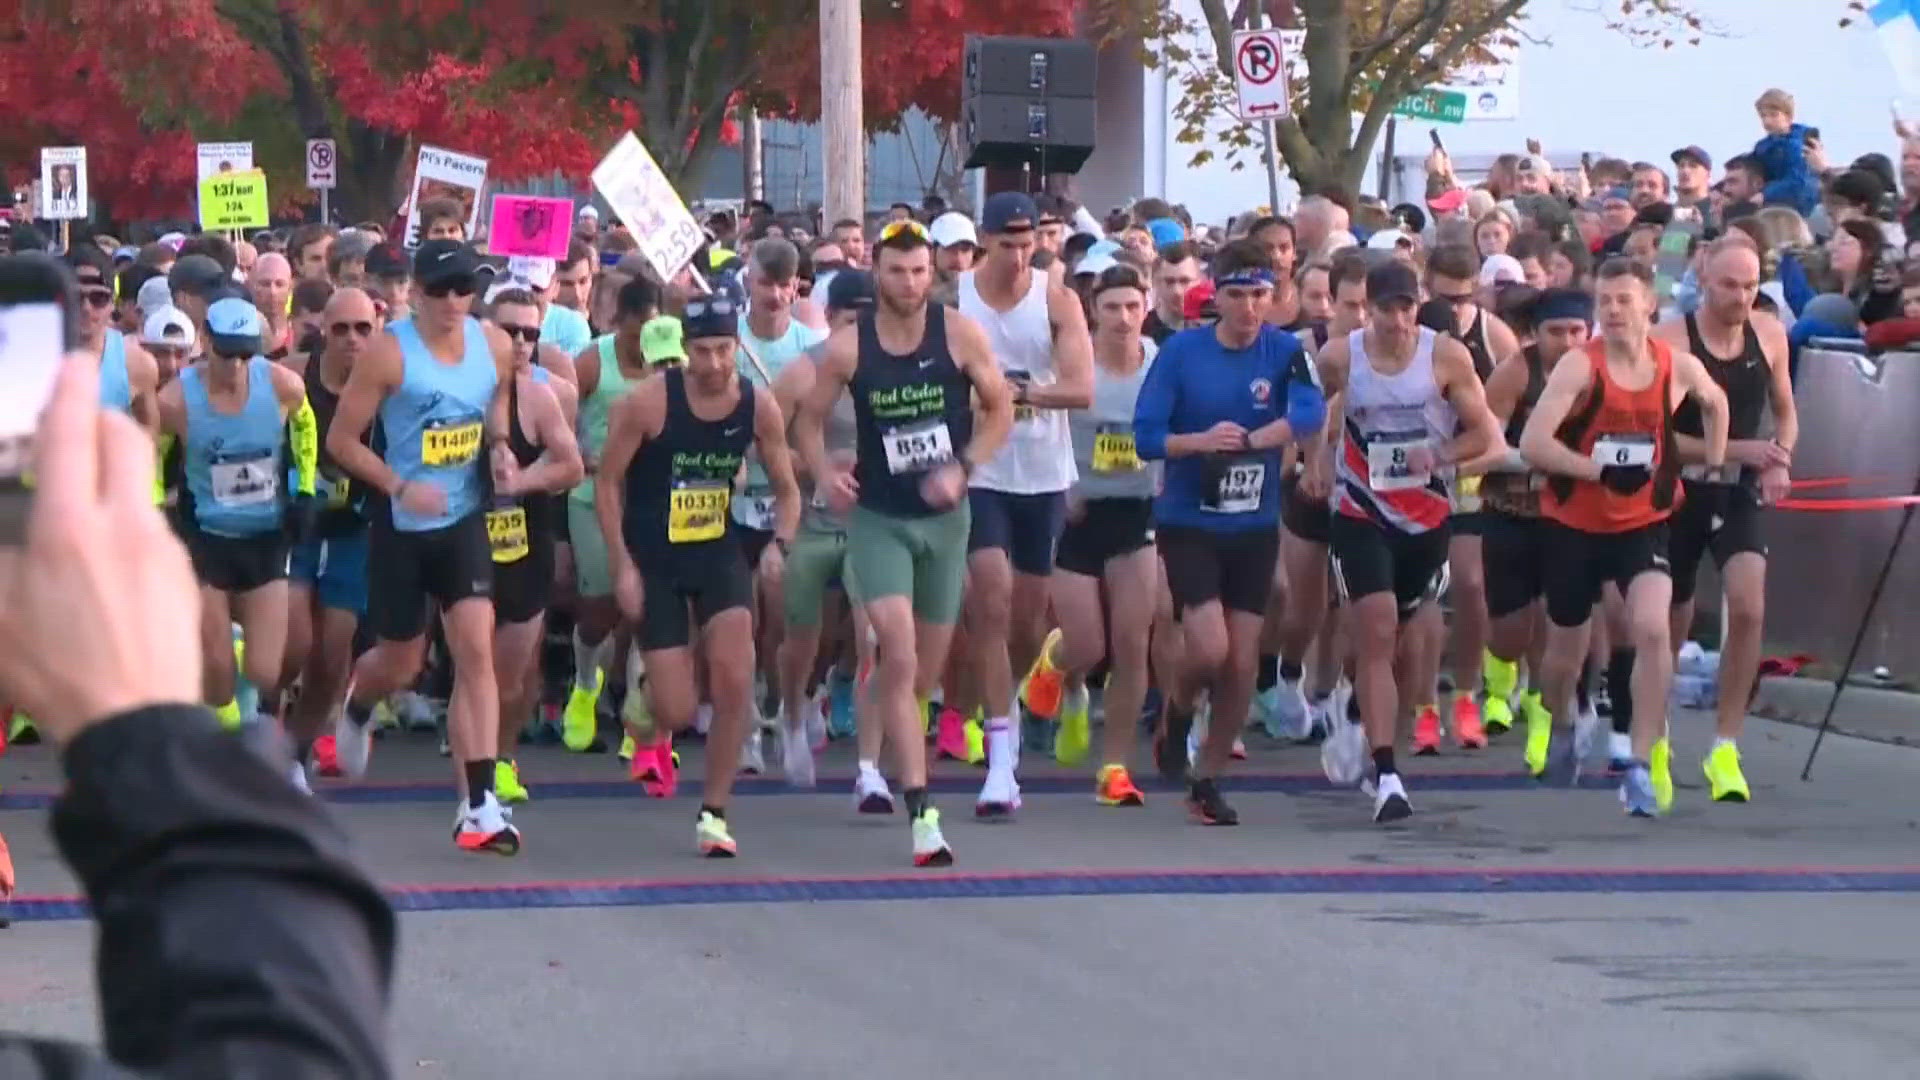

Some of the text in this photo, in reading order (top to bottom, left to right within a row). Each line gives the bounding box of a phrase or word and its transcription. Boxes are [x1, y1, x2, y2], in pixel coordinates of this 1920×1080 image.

[653, 220, 697, 276] 2:59
[868, 382, 944, 407] Red Cedar
[896, 432, 937, 456] 851
[1616, 448, 1630, 465] 6
[237, 464, 250, 480] 4
